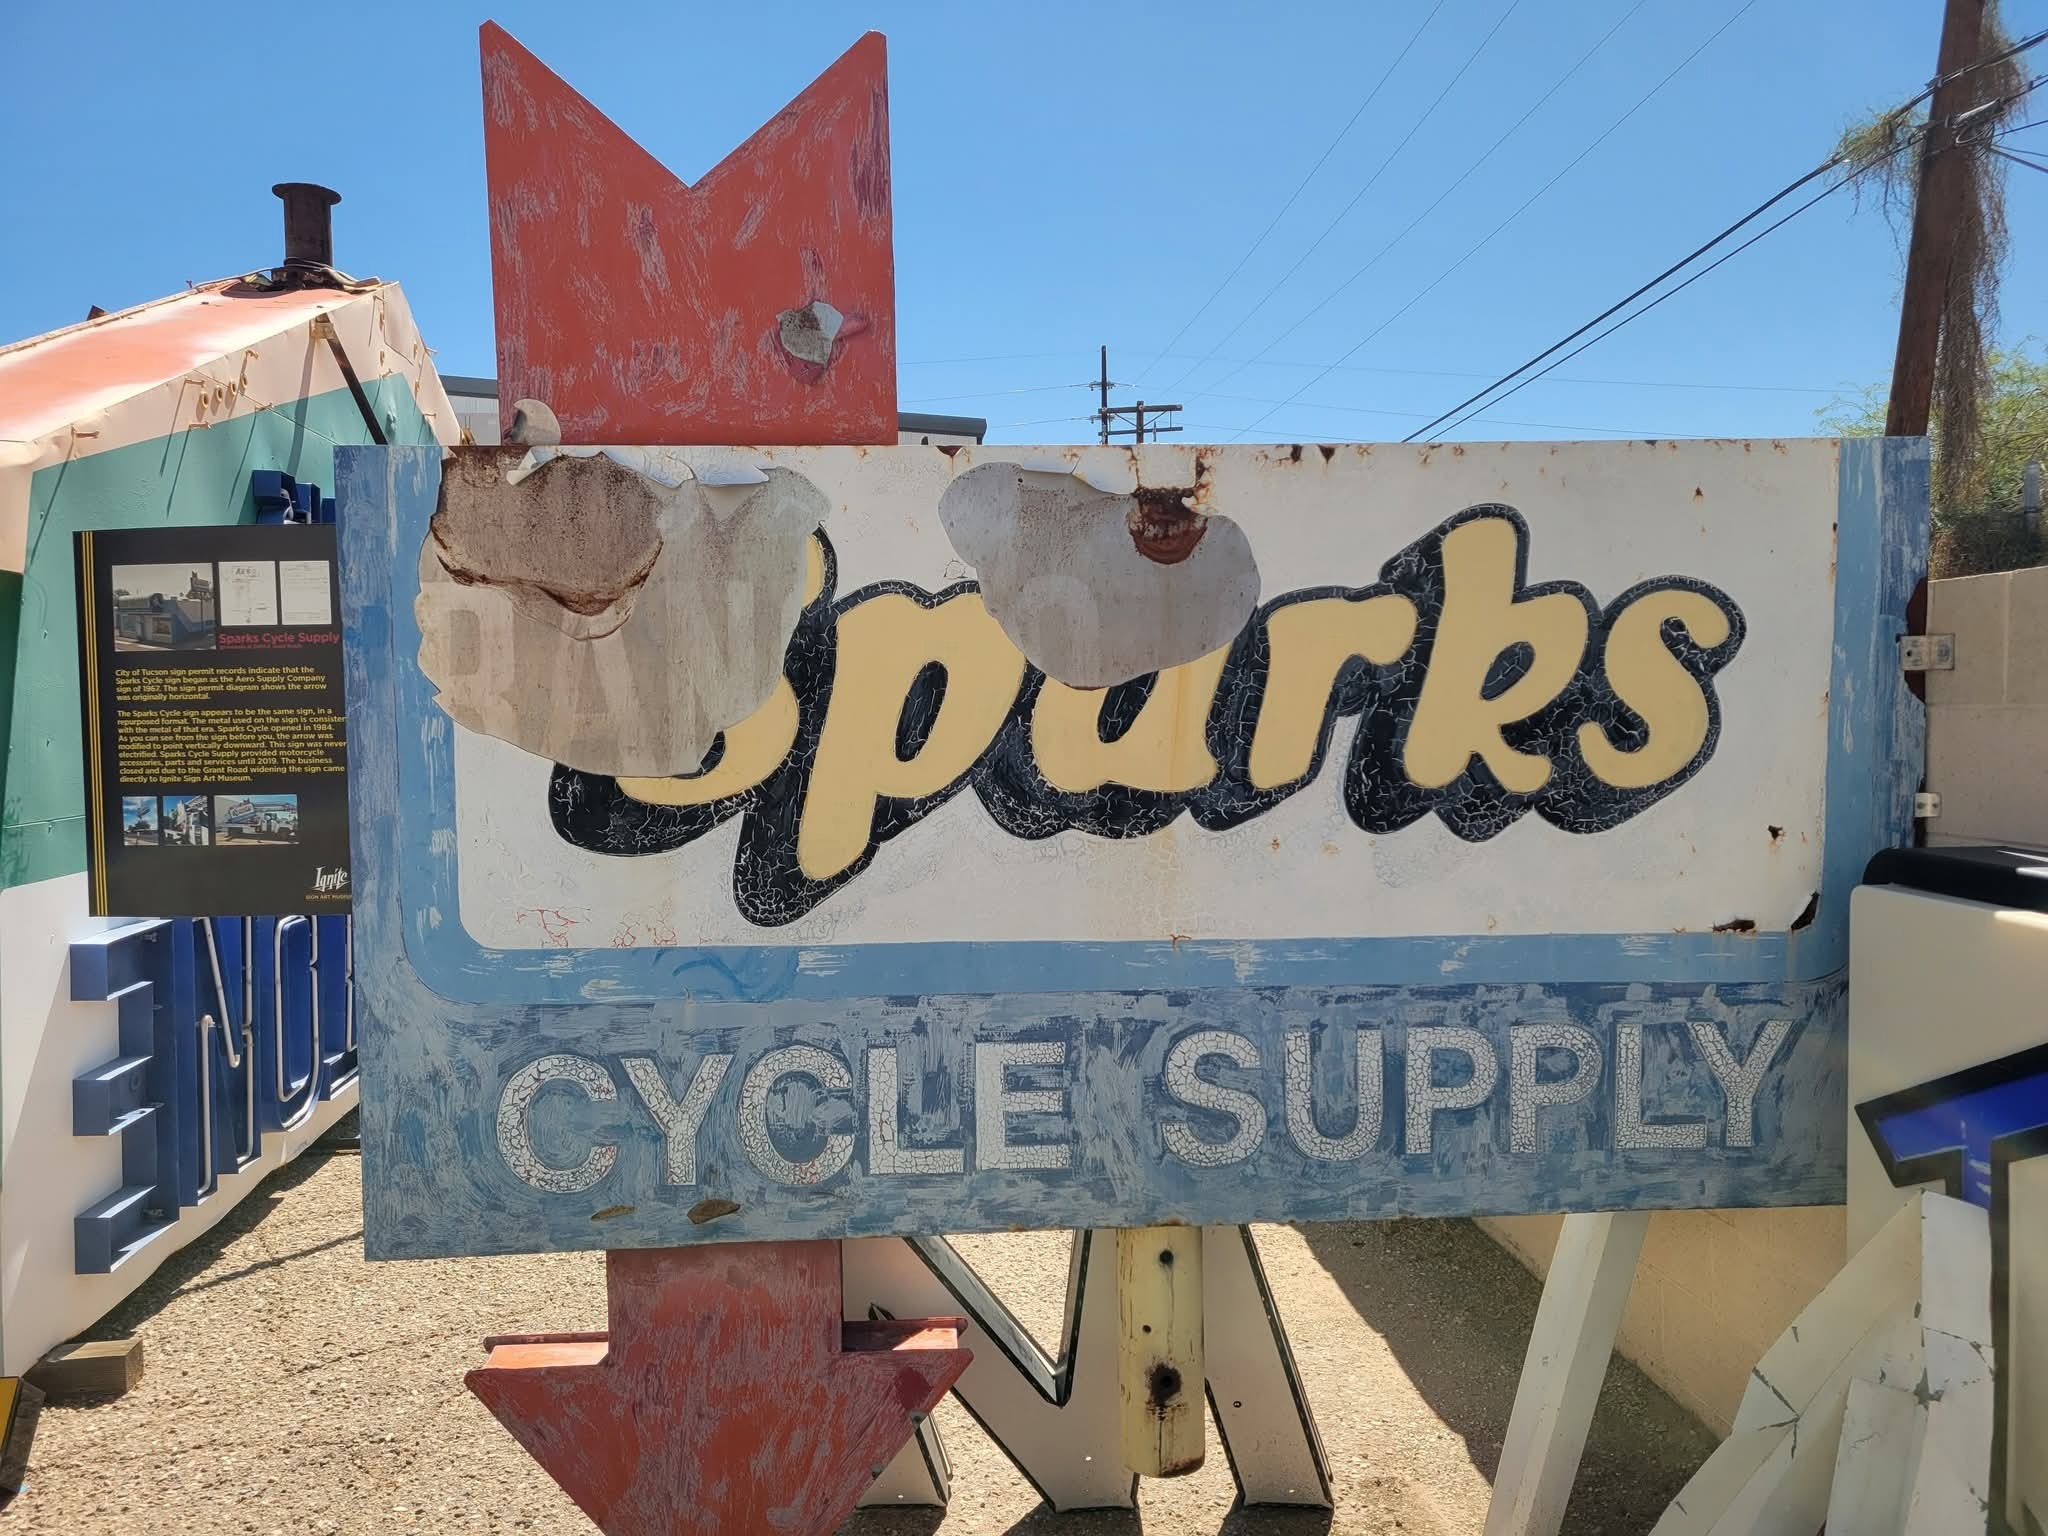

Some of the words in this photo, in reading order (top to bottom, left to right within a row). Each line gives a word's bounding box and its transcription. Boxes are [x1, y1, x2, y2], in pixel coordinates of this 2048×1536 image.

[219, 634, 259, 645] Sparks
[262, 633, 295, 644] Cycle
[299, 632, 340, 644] Supply
[257, 675, 284, 684] Supply
[287, 675, 326, 684] Company
[226, 683, 259, 692] diagram
[282, 716, 298, 725] sign
[218, 725, 245, 734] Sparks
[246, 725, 268, 733] Cycle
[271, 724, 301, 733] opened
[288, 741, 304, 749] sign
[241, 749, 277, 758] provided
[280, 748, 325, 757] motorcycle
[250, 766, 287, 774] widening
[304, 765, 321, 774] sign
[312, 866, 351, 892] Ignite
[496, 1038, 1072, 1193] CYCLE
[1162, 1018, 1795, 1168] SUPPLY
